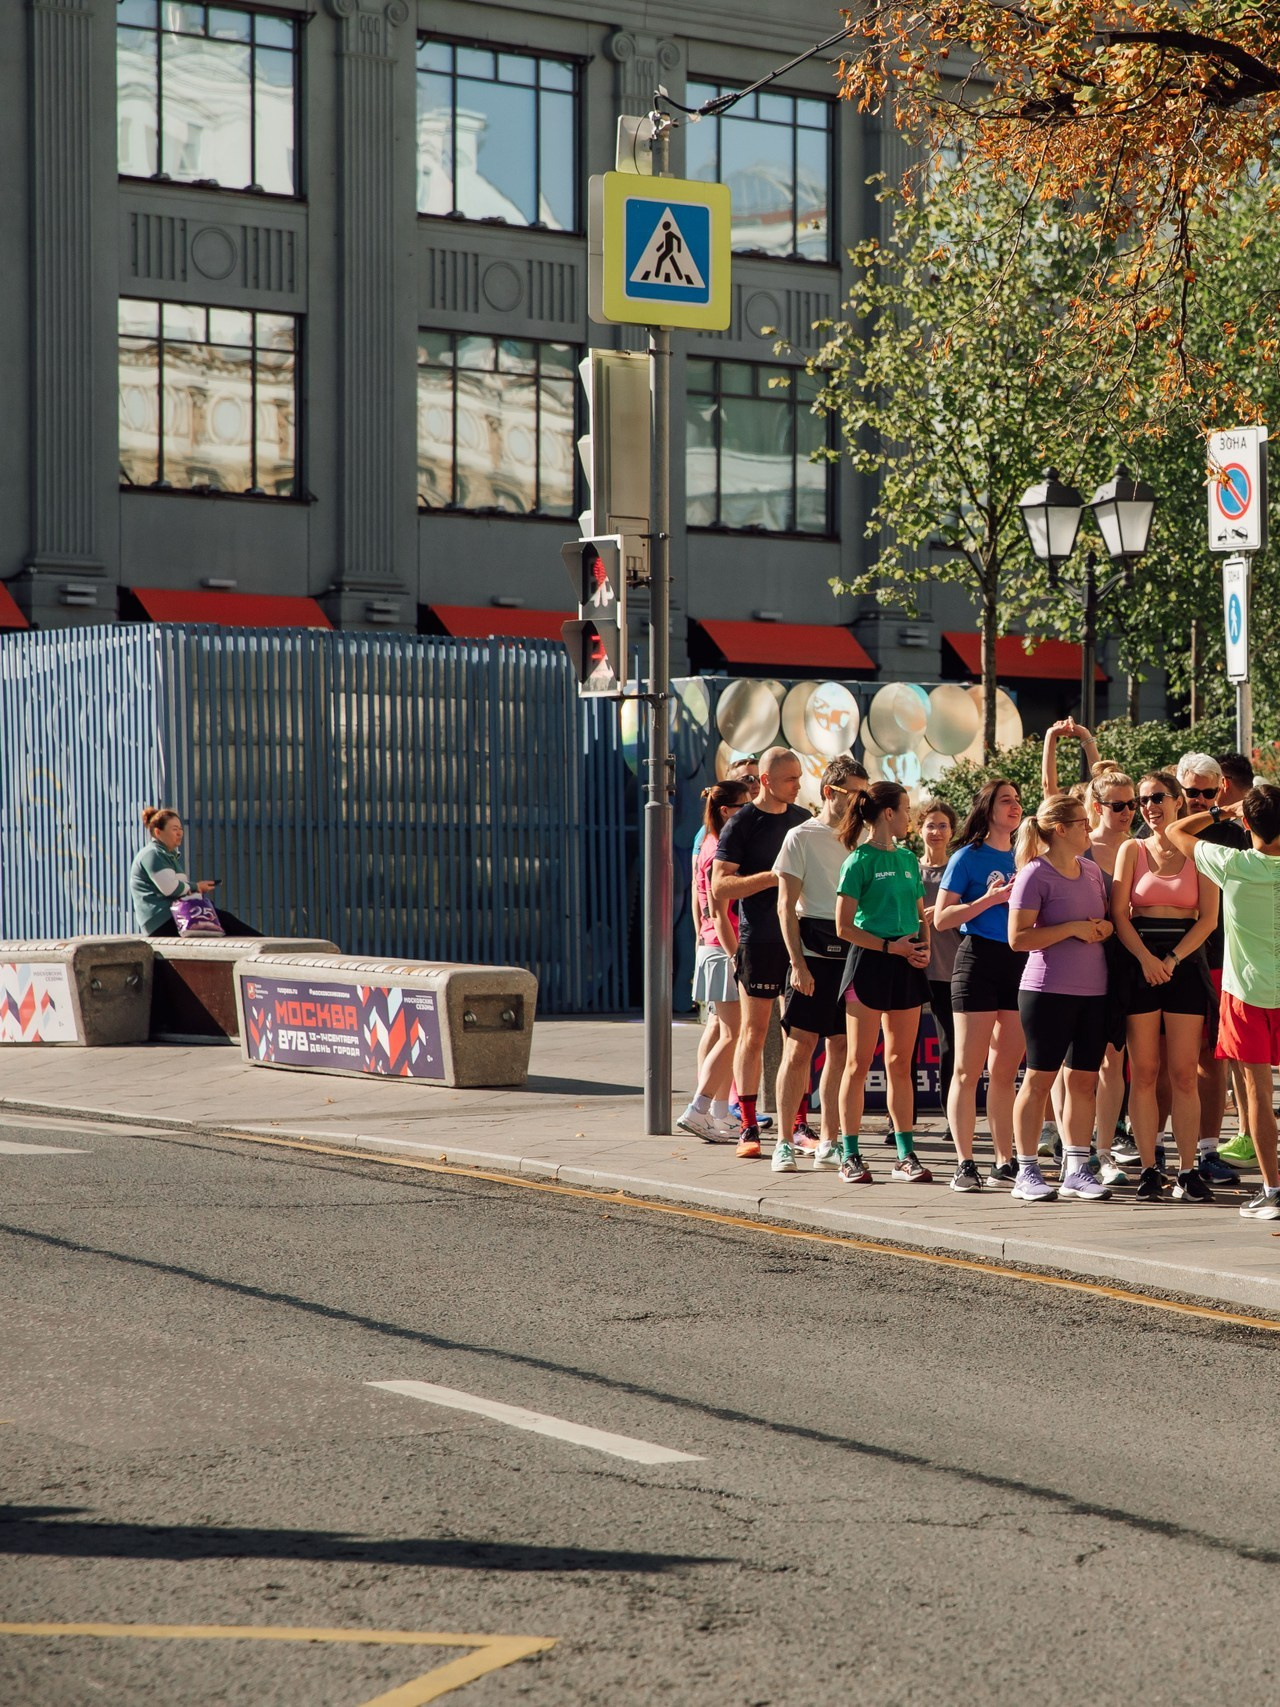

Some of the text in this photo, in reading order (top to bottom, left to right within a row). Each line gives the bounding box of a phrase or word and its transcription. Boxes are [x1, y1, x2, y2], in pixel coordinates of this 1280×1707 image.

[1220, 437, 1247, 450] ЗОНА
[275, 1000, 358, 1031] МОСКВА
[278, 1029, 309, 1051] 878
[310, 1043, 361, 1057] ДЕНЬ ГОРОДА
